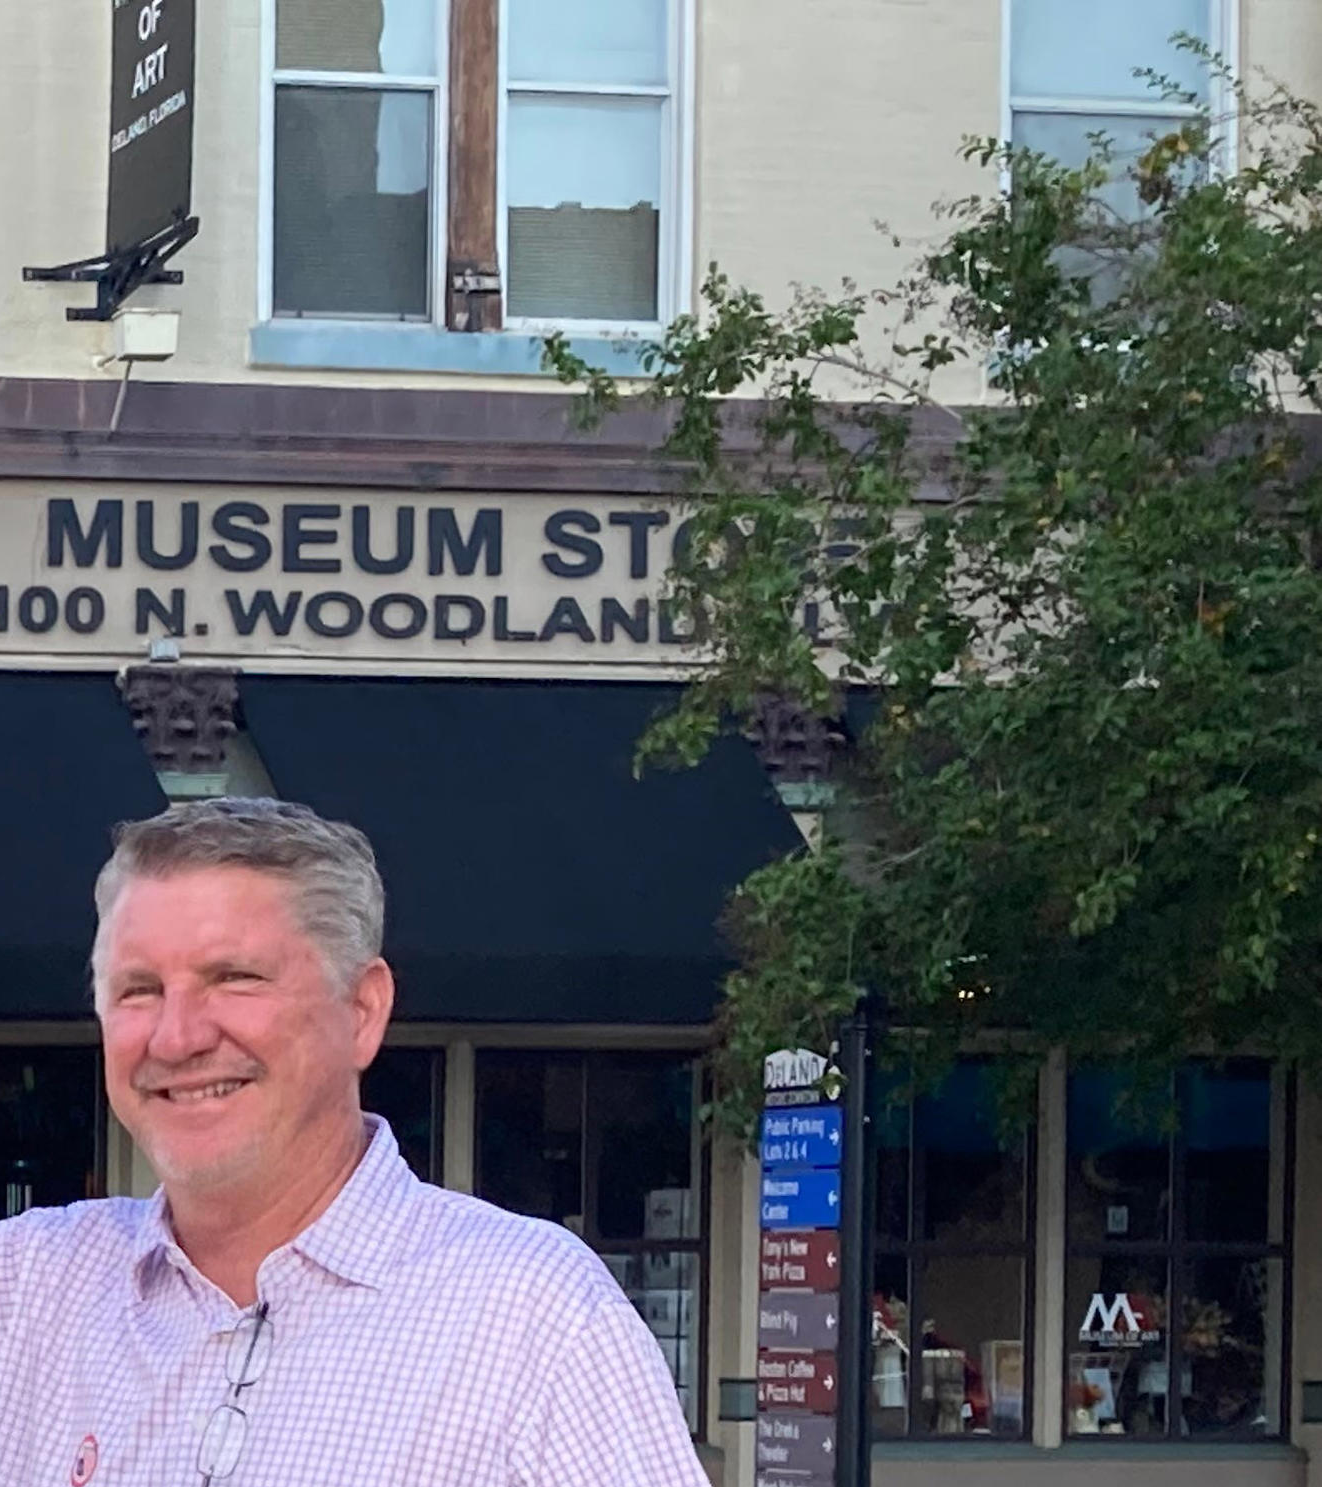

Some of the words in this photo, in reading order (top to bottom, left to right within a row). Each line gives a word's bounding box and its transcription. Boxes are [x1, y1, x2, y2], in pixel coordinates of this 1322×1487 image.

[138, 0, 163, 41] OF
[131, 43, 168, 99] ART
[46, 498, 503, 578] MUSEUM
[134, 587, 209, 637] N.
[765, 1118, 790, 1136] Public
[792, 1116, 825, 1139] Parking
[784, 1140, 790, 1160] 2
[800, 1140, 807, 1159] 4
[790, 1238, 808, 1256] New
[760, 1310, 782, 1329] Blind
[784, 1310, 798, 1337] Pig
[788, 1359, 815, 1378] Coffee
